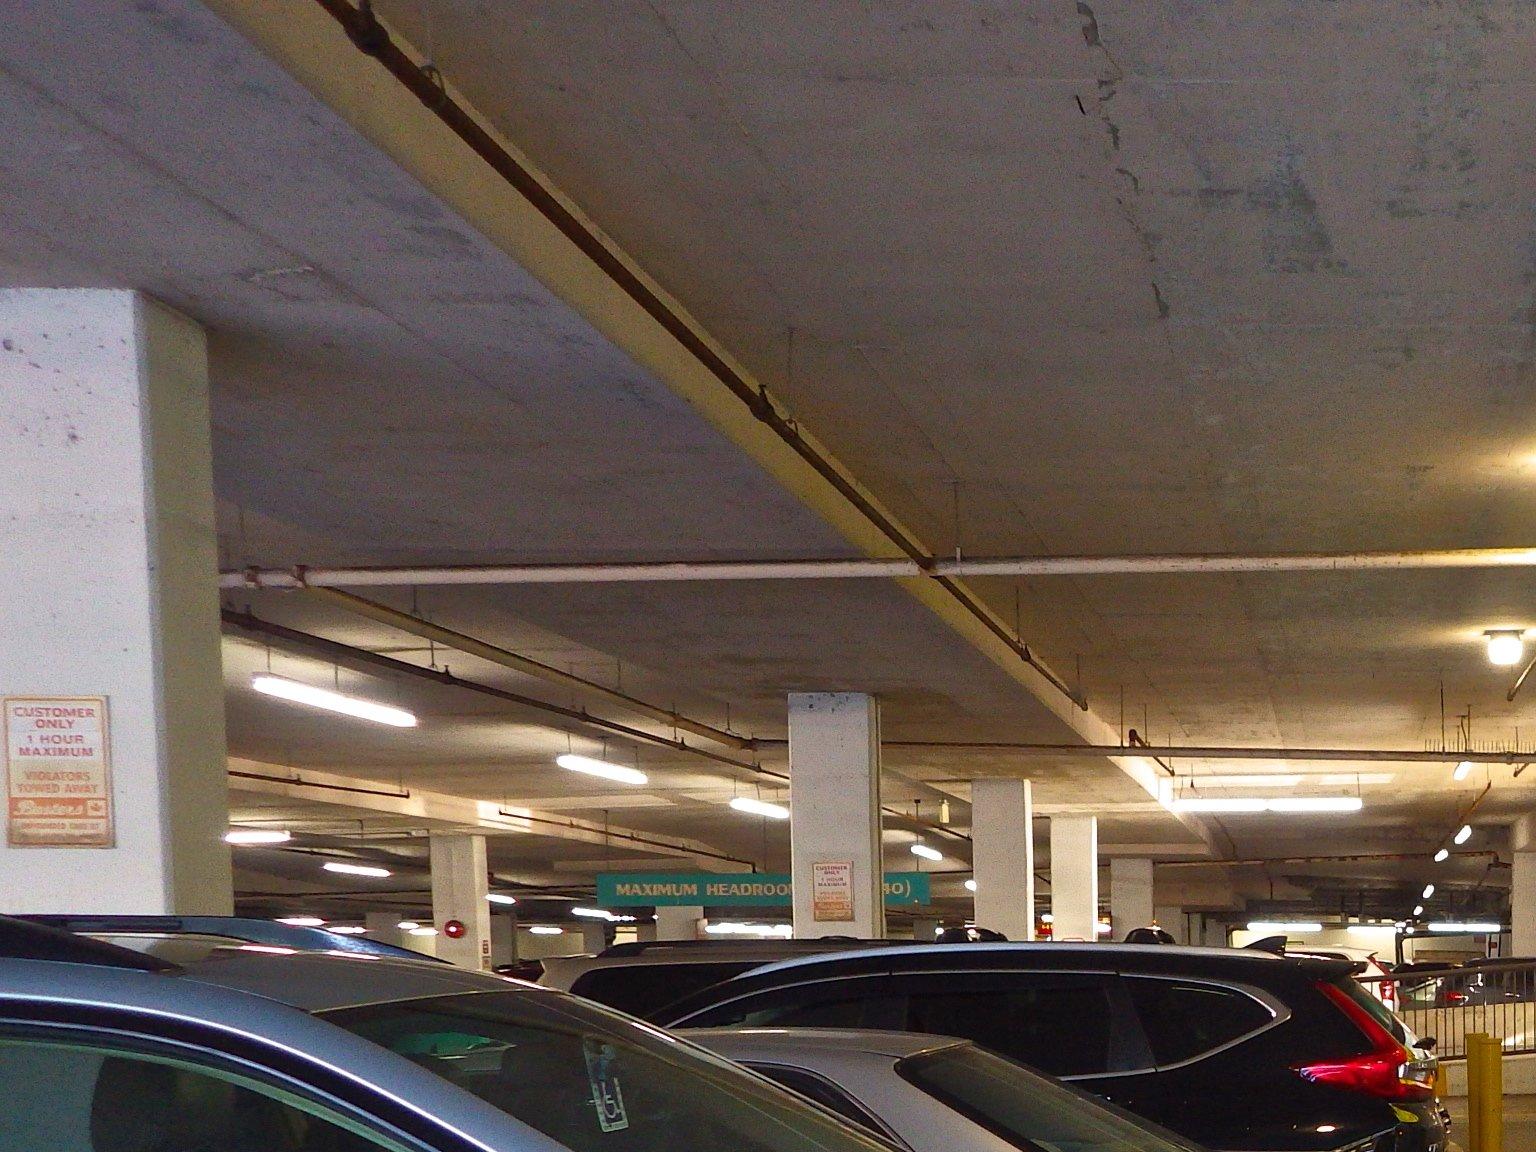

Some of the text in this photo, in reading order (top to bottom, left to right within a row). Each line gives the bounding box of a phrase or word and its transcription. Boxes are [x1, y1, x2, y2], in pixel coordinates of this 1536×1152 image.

[14, 707, 95, 718] CUSTOMER
[35, 719, 75, 729] ONLY
[40, 735, 84, 744] HOUR
[19, 747, 93, 757] MAXIMUM
[616, 883, 697, 896] MAXIMUM
